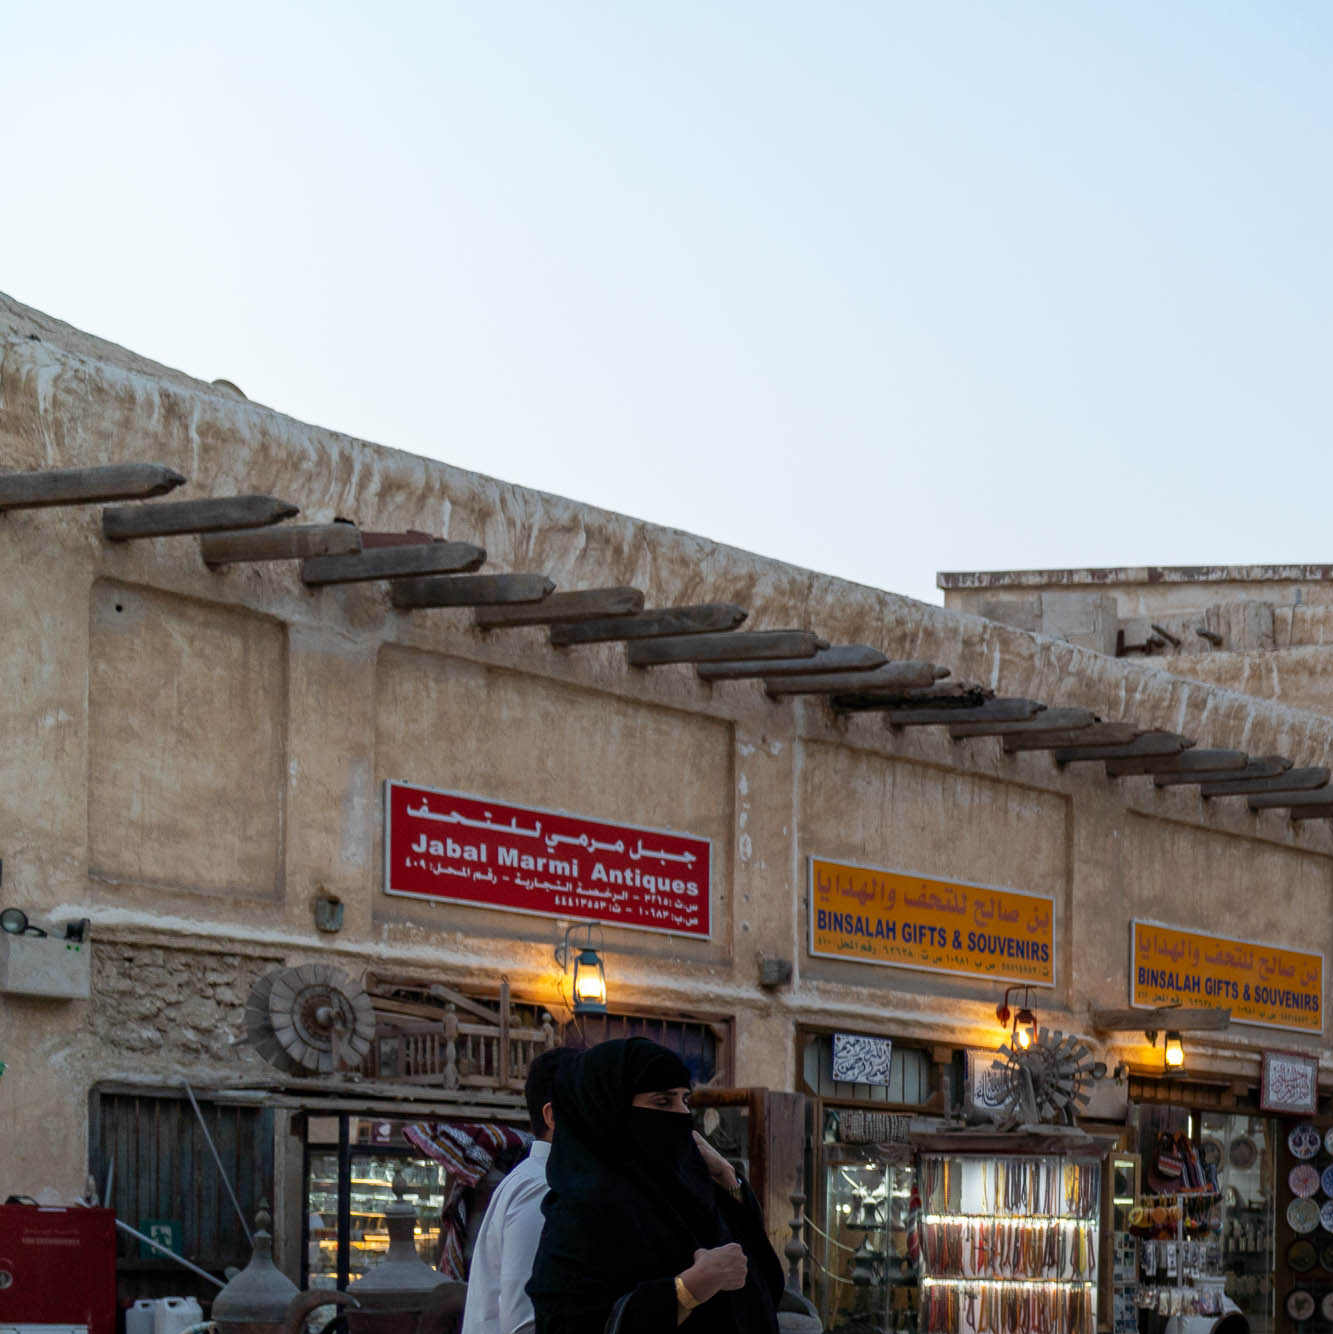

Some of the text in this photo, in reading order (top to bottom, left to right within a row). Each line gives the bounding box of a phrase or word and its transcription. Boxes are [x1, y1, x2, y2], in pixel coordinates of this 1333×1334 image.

[406, 797, 697, 870] جبل مرمي للتحف
[411, 833, 699, 897] Jabal Marmi Antiques
[817, 869, 897, 911] والهدايا
[904, 884, 968, 915] للتحف
[818, 909, 1050, 963] BINSALAH GIFTS & SOUVENIRS
[1138, 966, 1200, 993] BINSALAH
[1205, 977, 1239, 1000] GIFTS
[1243, 983, 1251, 1001] &
[1254, 986, 1319, 1012] SOUVENIRS
